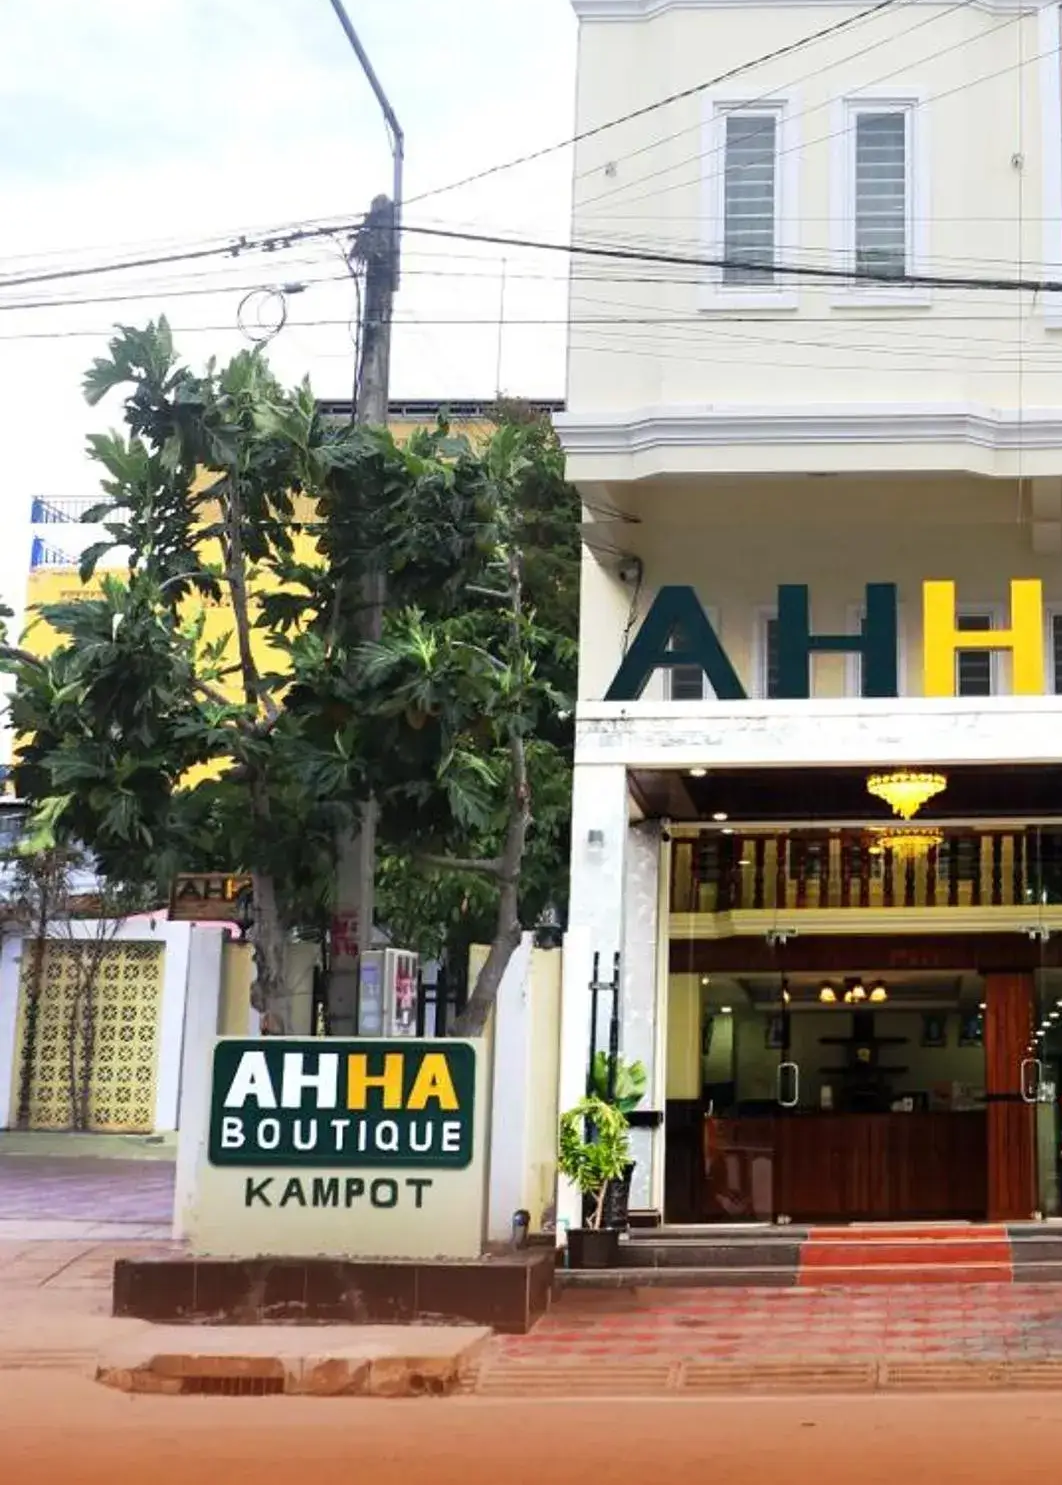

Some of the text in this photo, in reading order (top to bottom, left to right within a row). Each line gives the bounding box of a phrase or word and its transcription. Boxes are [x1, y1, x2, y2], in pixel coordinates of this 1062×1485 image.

[223, 1051, 459, 1110] AHHA
[221, 1116, 461, 1152] BOUTIQUE
[245, 1177, 433, 1208] KAMPOT
